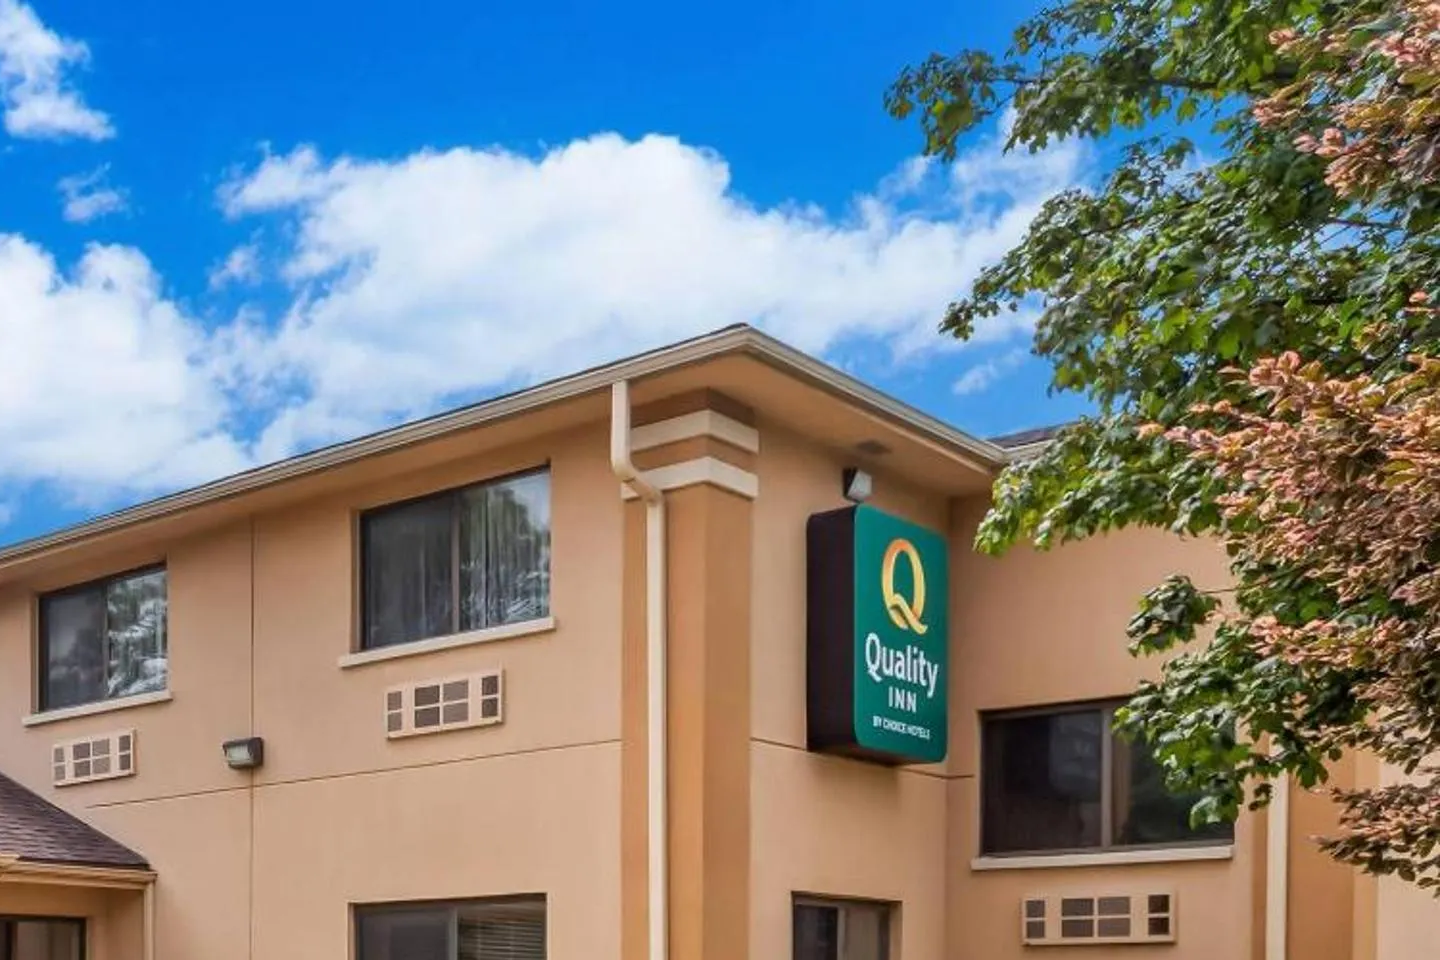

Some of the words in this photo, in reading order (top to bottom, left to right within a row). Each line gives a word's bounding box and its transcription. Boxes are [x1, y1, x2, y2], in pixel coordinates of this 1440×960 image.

[882, 538, 928, 634] Q
[865, 632, 939, 698] Quality
[888, 686, 917, 713] INN
